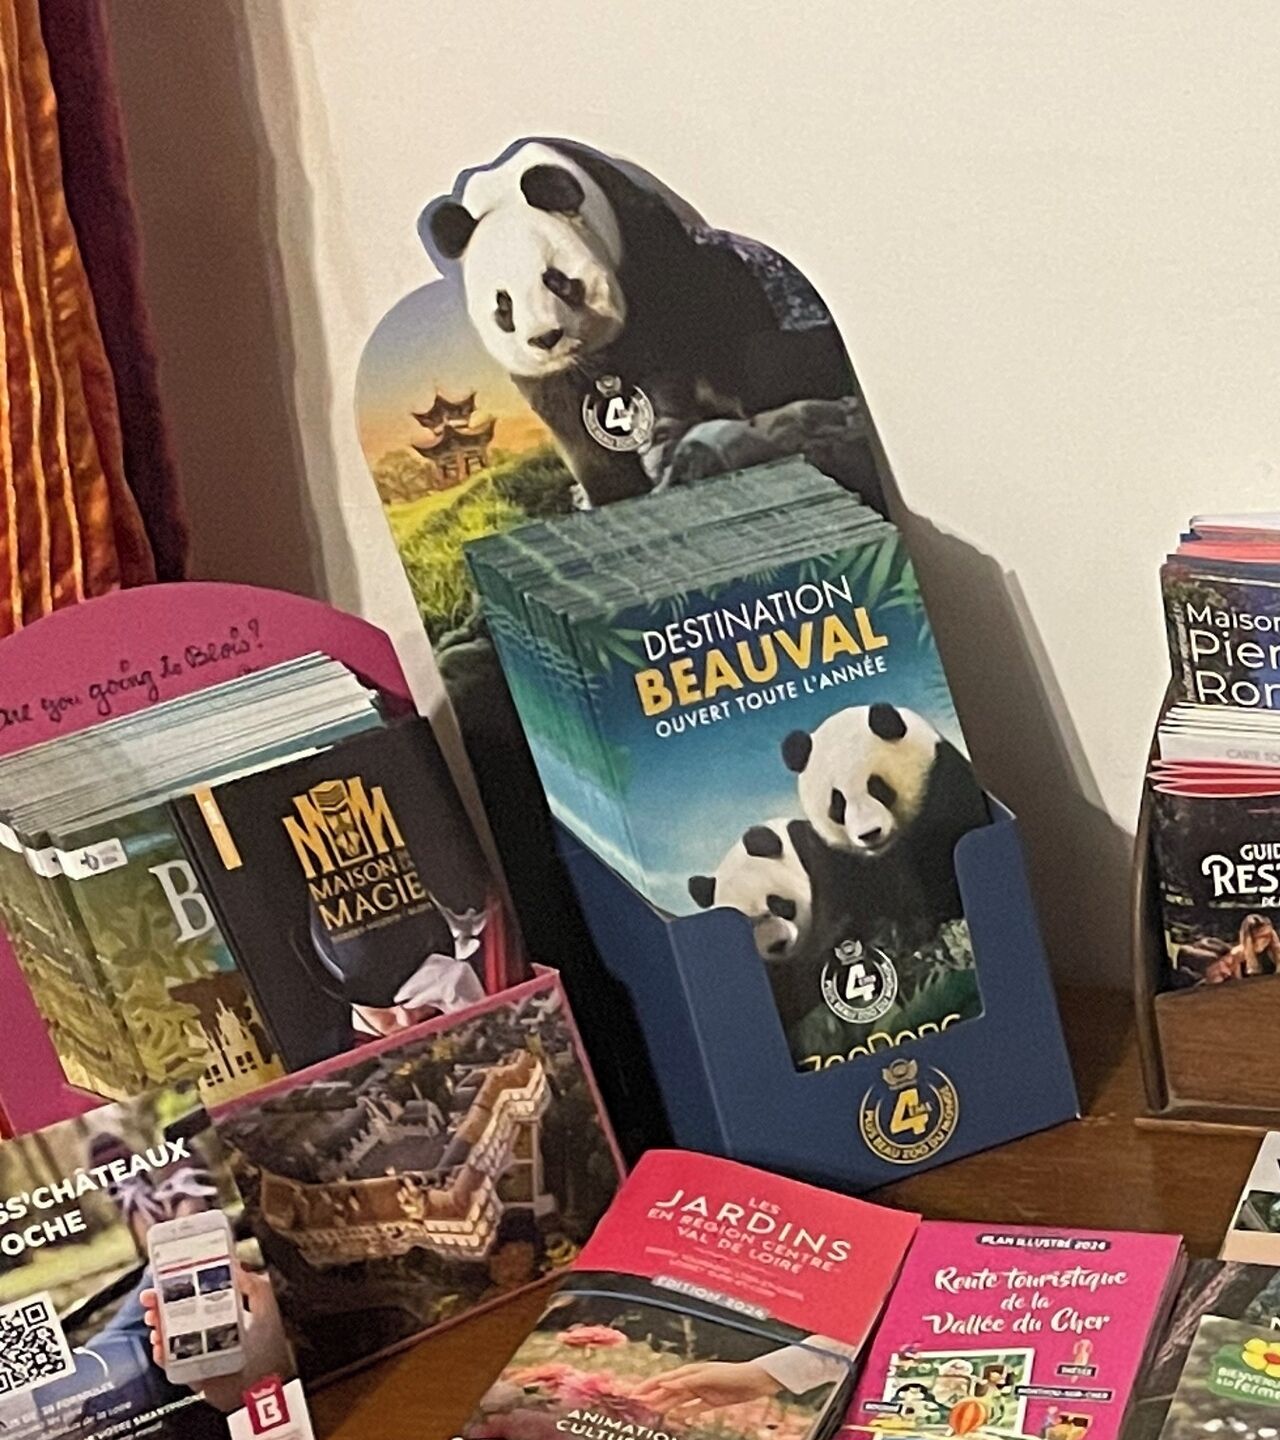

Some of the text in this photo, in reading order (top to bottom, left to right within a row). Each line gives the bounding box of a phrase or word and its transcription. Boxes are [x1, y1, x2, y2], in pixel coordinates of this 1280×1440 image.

[643, 575, 853, 661] DESTINATION
[635, 607, 888, 716] BEAUVAL
[89, 659, 160, 716] going
[160, 656, 183, 678] to
[655, 655, 888, 738] OUVERT TOUTE L'ANNÉE
[308, 854, 399, 902] MAISON
[318, 871, 426, 931] MAGIE
[846, 964, 876, 1002] 4
[890, 1088, 929, 1135] 4
[874, 1137, 900, 1158] BEAU
[902, 1143, 927, 1159] ZOO
[930, 1131, 944, 1148] DU
[648, 1208, 674, 1221] EN
[655, 1189, 852, 1262] JARDINS
[749, 1198, 781, 1215] LES
[0, 1209, 87, 1257] OCHE
[677, 1226, 804, 1275] VAL DE LOIRE
[981, 1235, 1014, 1246] PLAN
[935, 1266, 1128, 1294] Route touristique
[1001, 1291, 1052, 1311] de la
[922, 1307, 1110, 1335] Vallée du Cher
